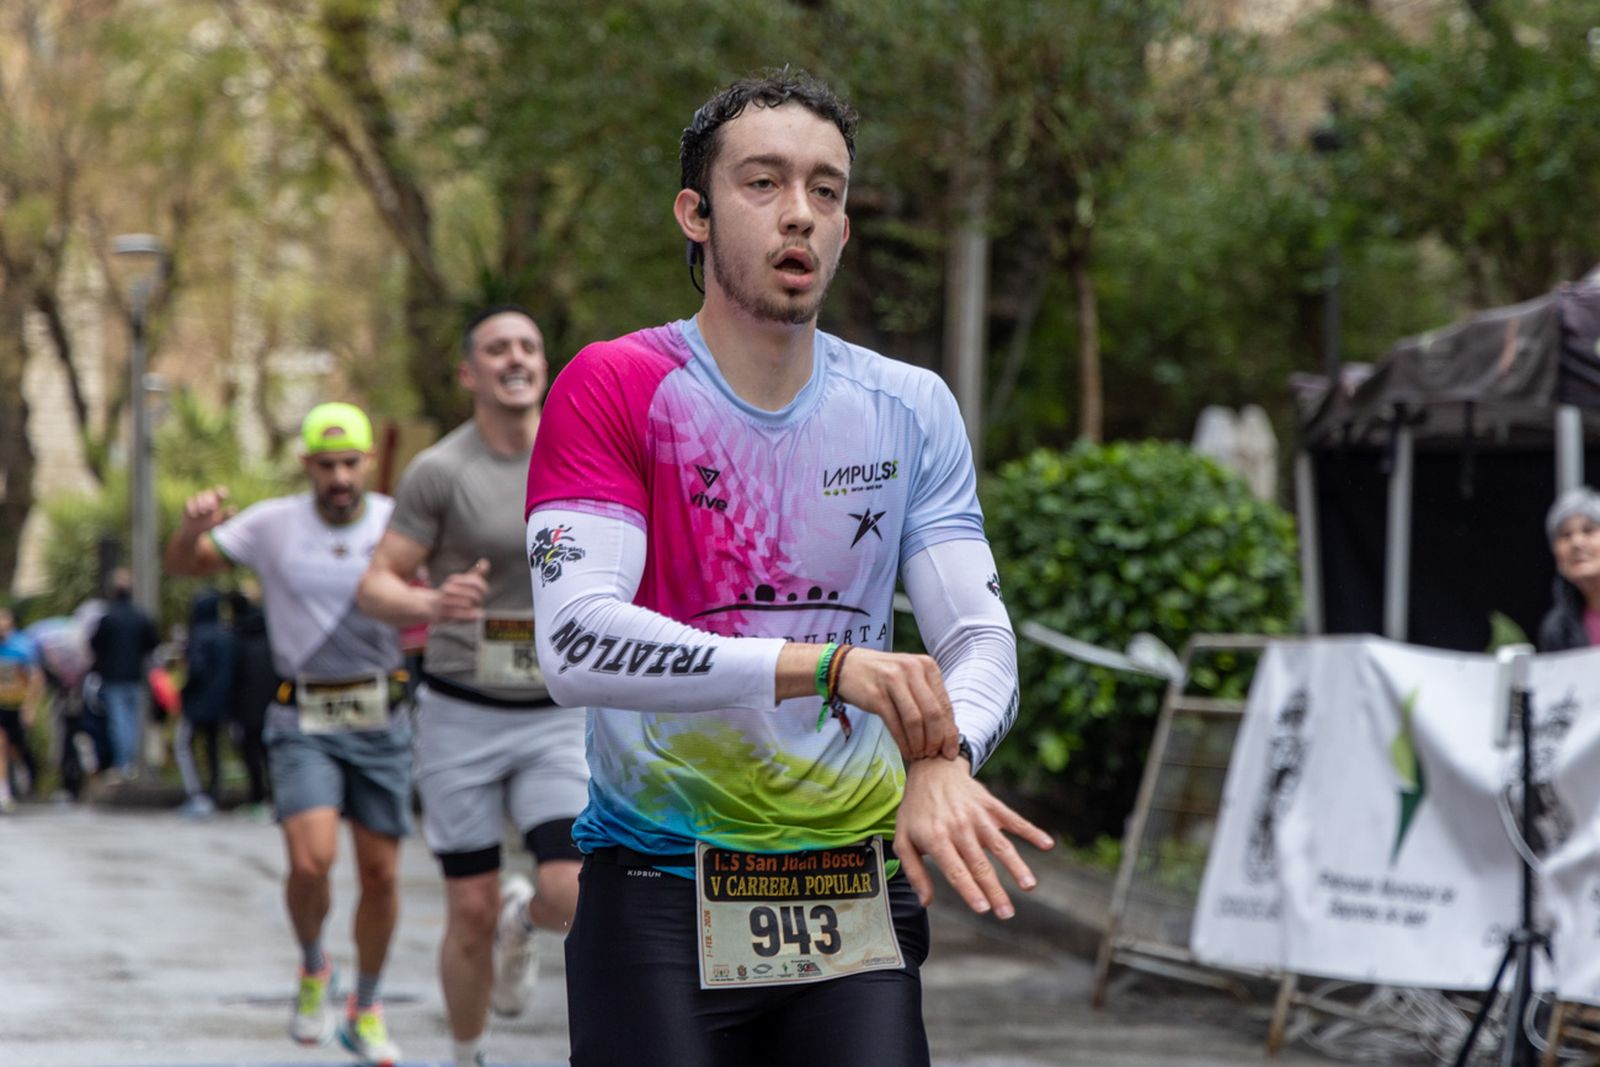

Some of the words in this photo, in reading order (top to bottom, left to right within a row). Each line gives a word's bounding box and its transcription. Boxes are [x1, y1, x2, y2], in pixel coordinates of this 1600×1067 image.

[690, 490, 728, 512] vive
[745, 853, 778, 872] San
[710, 876, 722, 896] V
[727, 875, 800, 897] CARRERA
[804, 872, 873, 896] POPULAR
[749, 905, 842, 958] 943
